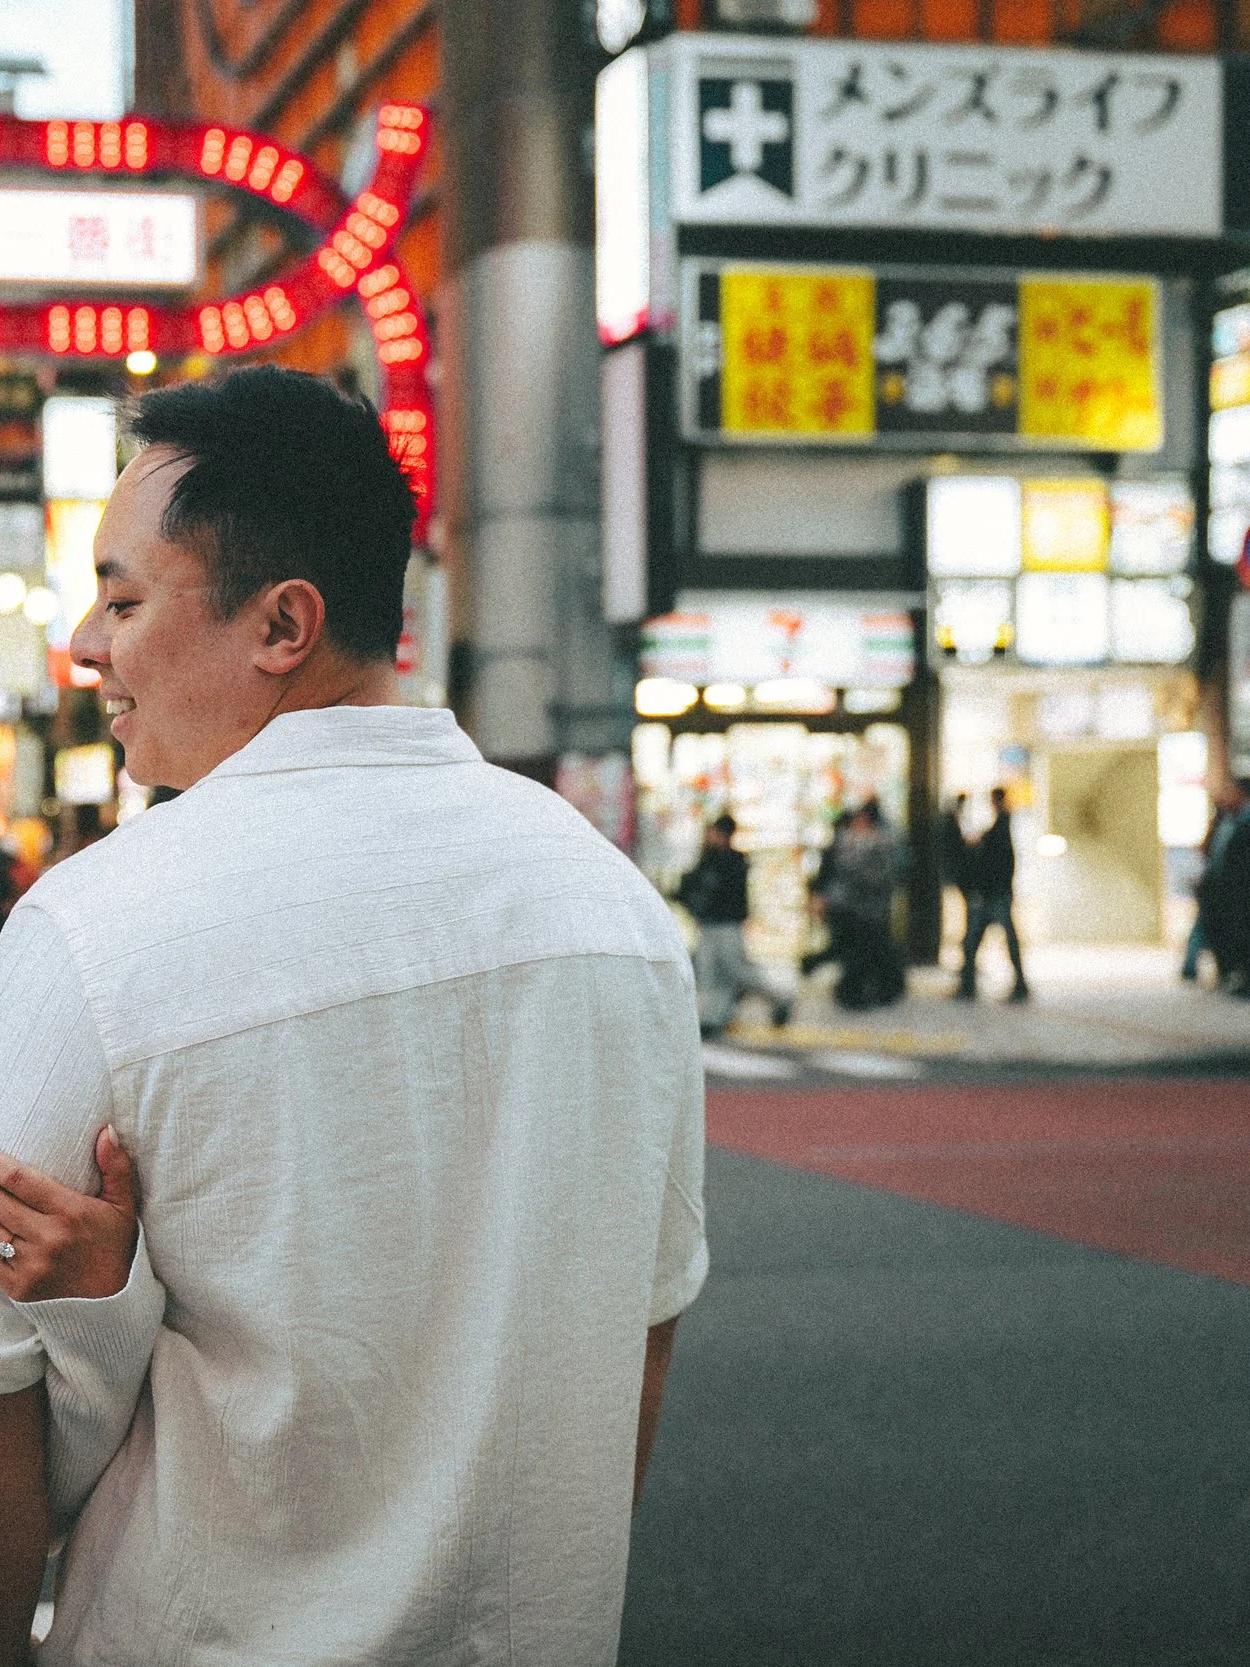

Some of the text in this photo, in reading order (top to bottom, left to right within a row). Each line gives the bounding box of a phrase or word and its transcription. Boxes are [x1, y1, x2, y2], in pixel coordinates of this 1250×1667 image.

[820, 60, 1182, 137] メンズライフ
[818, 146, 1114, 222] クリニック
